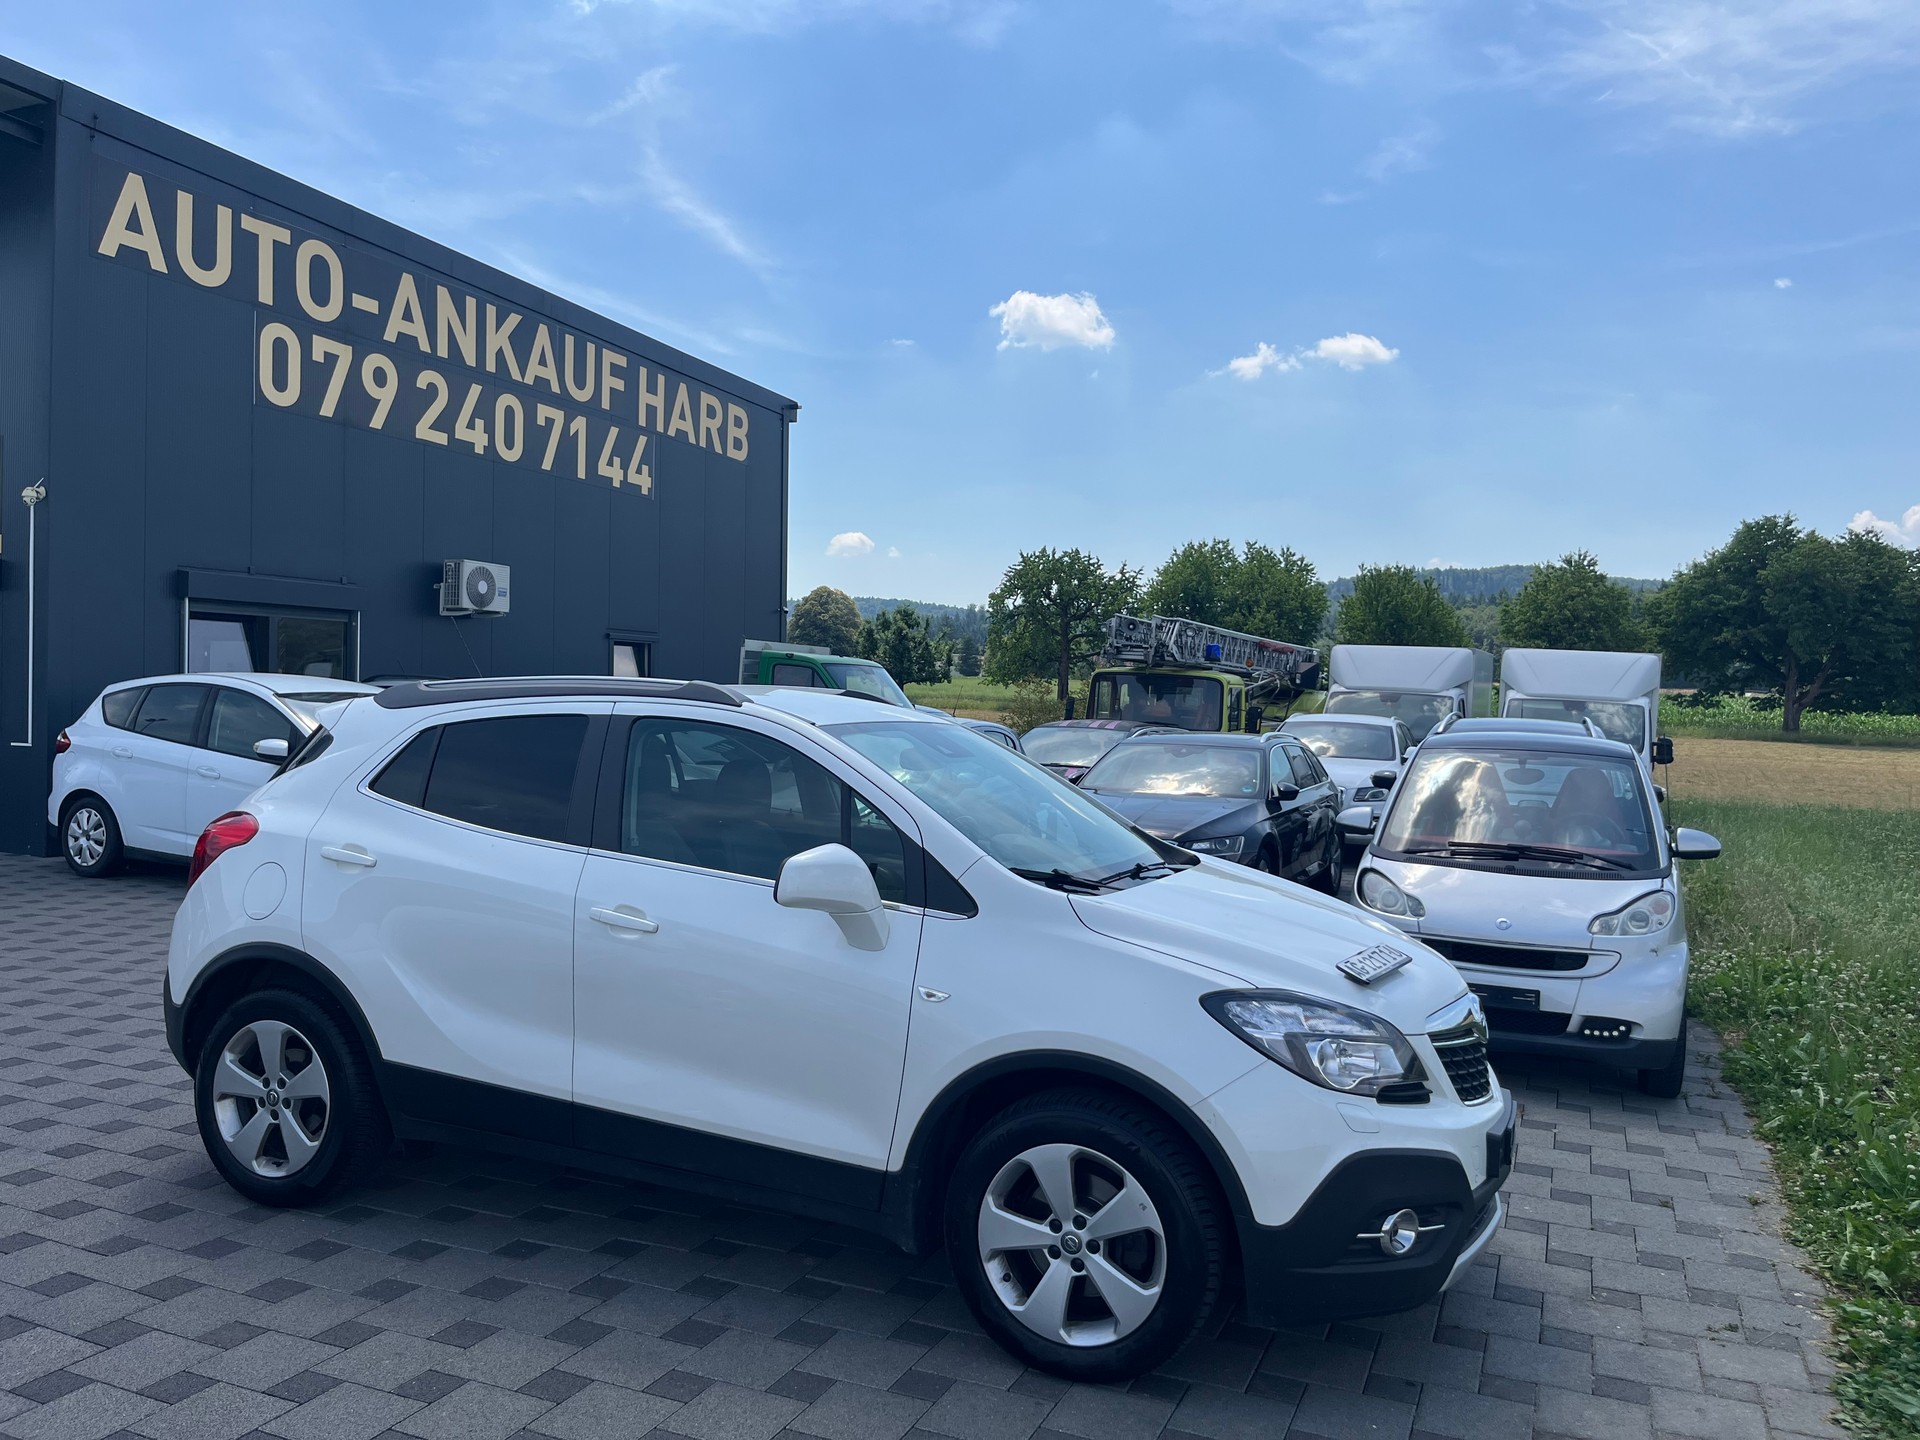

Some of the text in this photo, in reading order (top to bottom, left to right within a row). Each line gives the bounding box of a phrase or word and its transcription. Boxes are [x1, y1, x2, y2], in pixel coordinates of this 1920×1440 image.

[99, 173, 748, 460] AUTO-ANKAUF HARB
[258, 322, 652, 494] 079 240 7144
